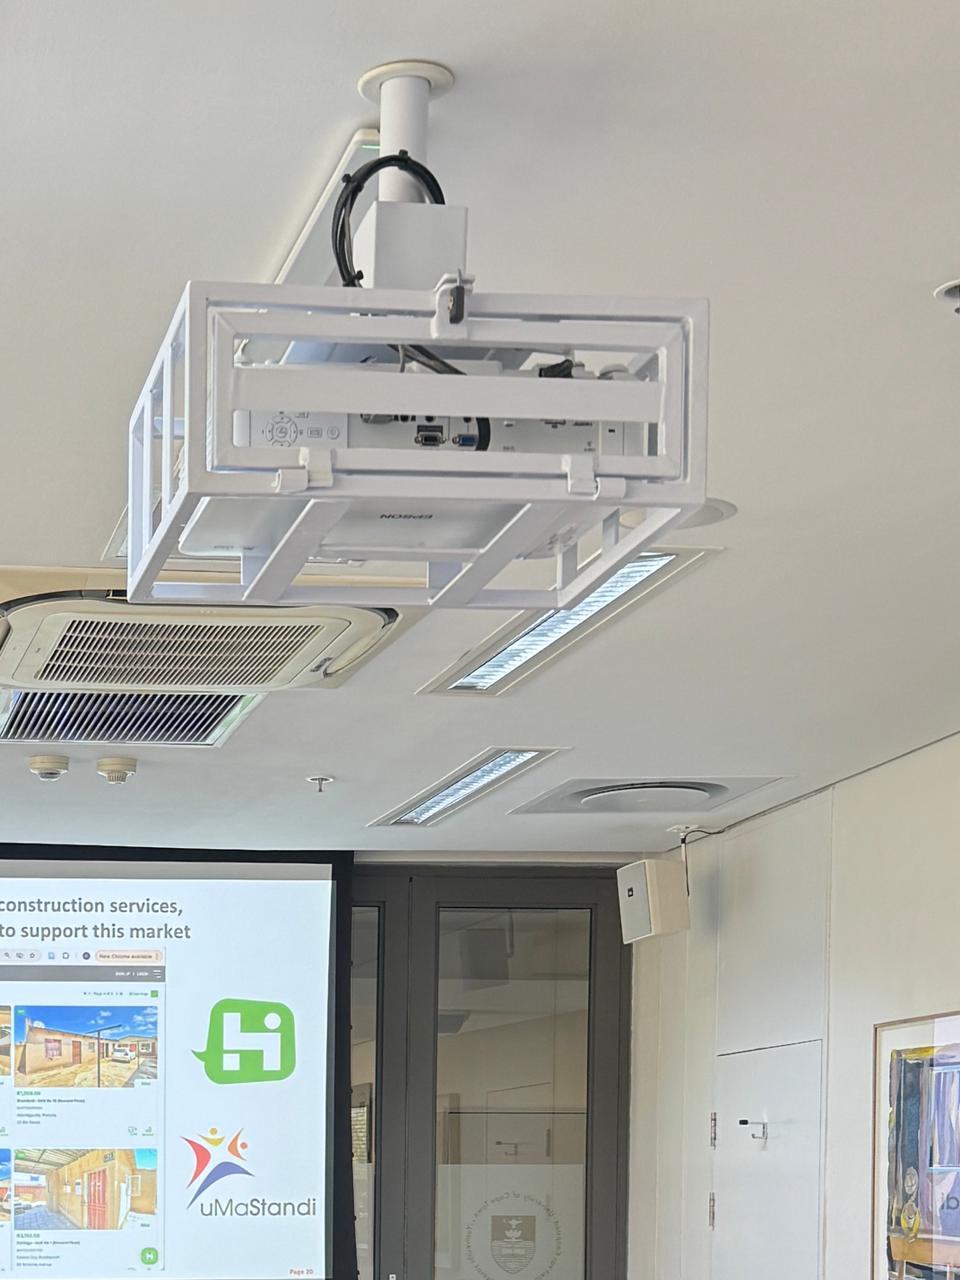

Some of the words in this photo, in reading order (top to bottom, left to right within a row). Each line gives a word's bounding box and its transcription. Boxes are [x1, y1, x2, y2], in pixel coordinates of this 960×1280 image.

[109, 898, 183, 916] services,
[20, 924, 89, 941] support
[92, 923, 125, 938] this
[129, 923, 191, 939] market
[200, 1198, 316, 1216] uMaStandi
[289, 1268, 304, 1276] Page
